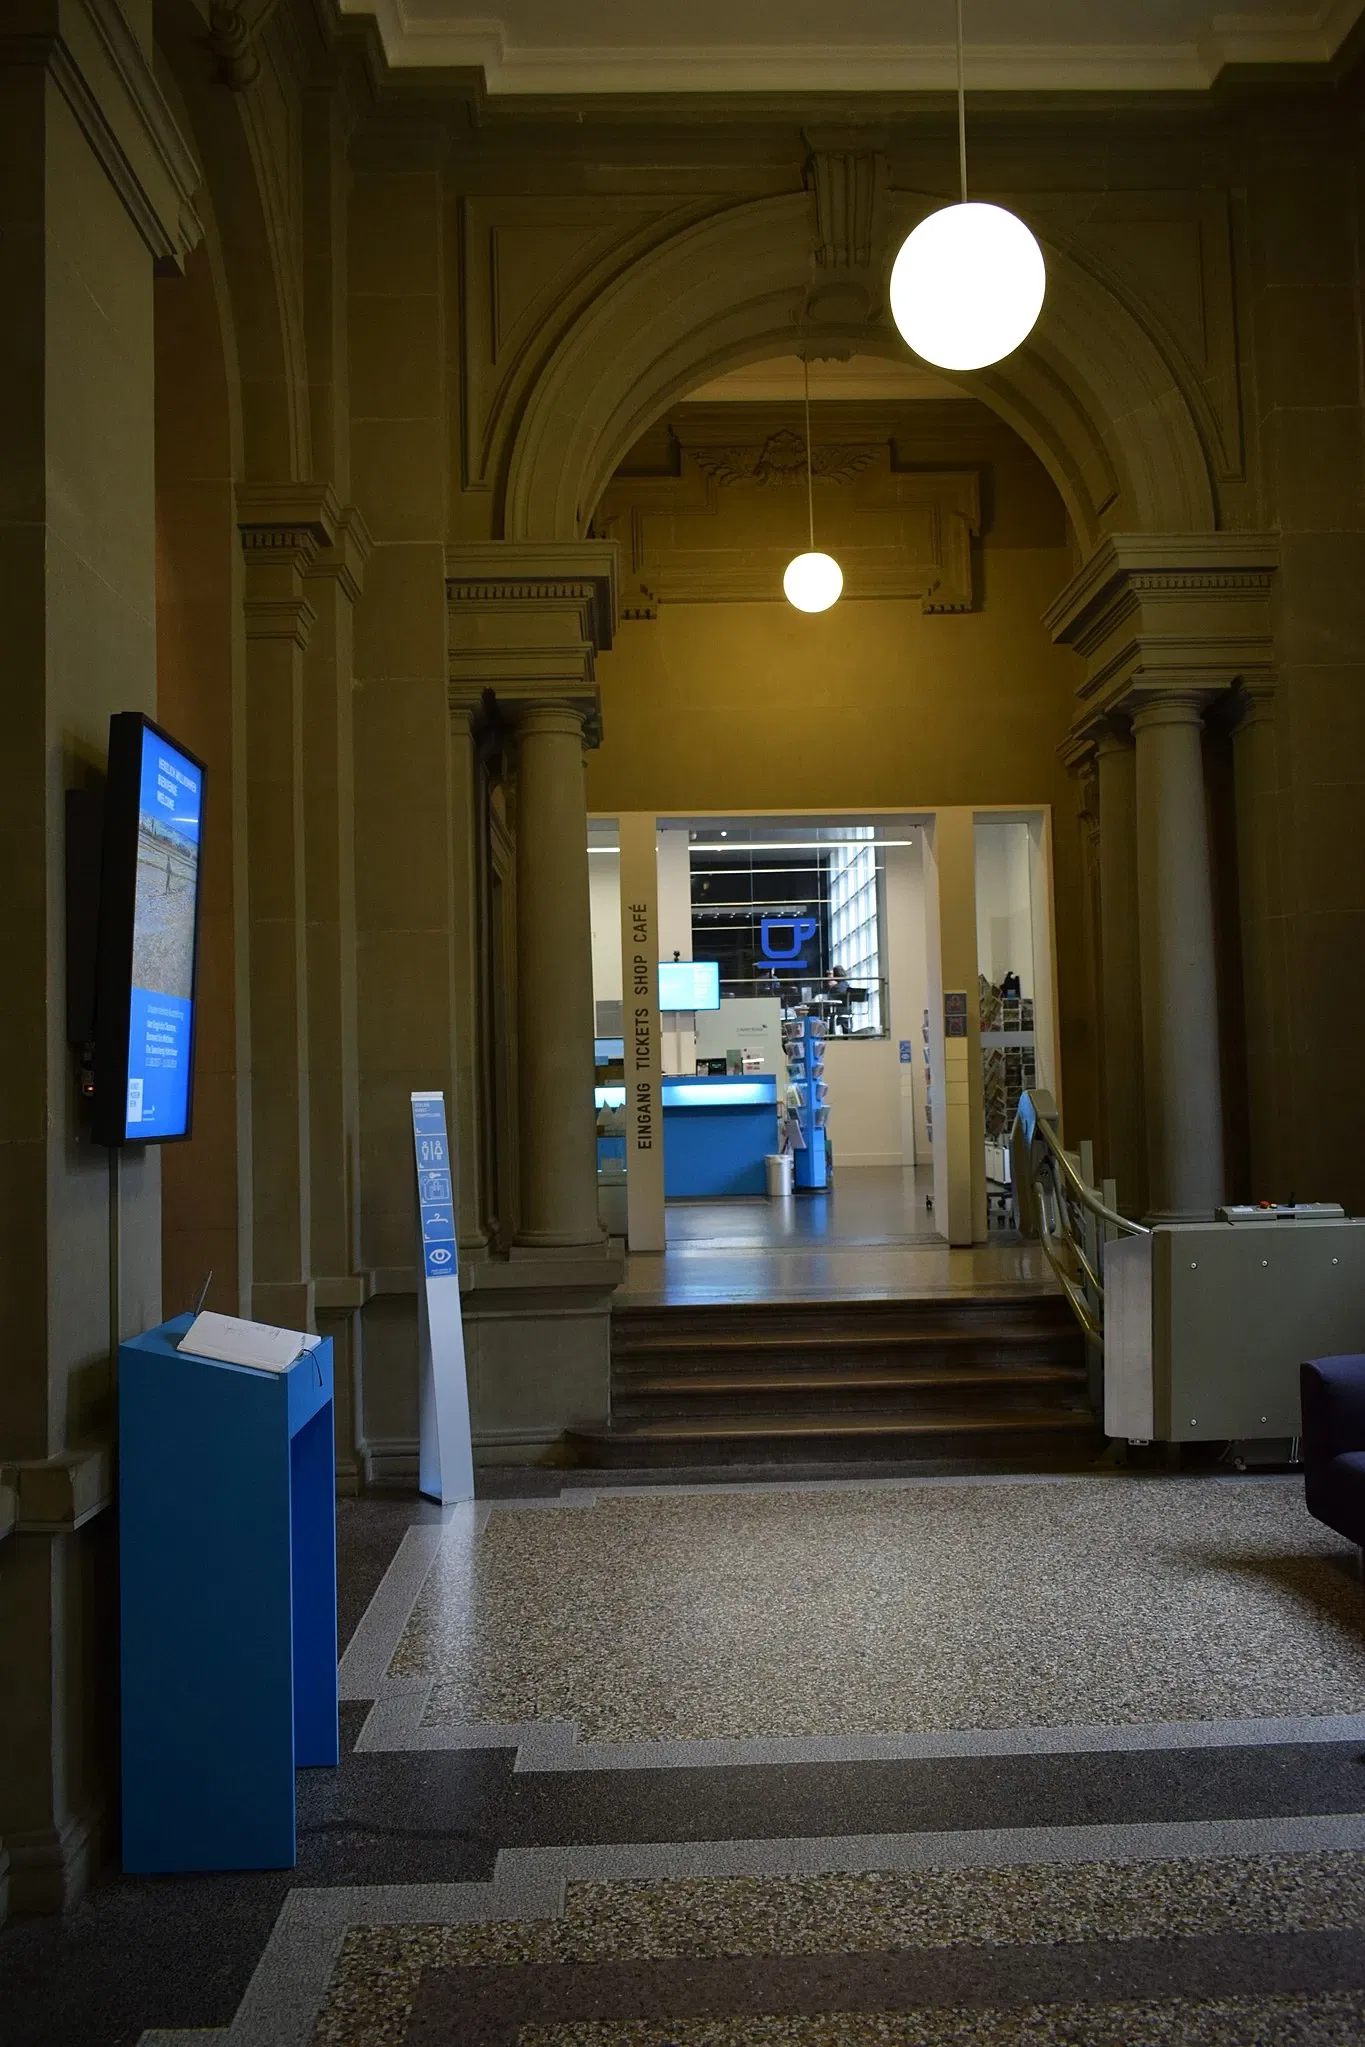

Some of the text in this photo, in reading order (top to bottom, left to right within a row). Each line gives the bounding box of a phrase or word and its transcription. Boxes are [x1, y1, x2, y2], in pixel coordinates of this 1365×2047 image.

[628, 903, 652, 1150] EINGANG TICKETS SHOP CAFÉ
